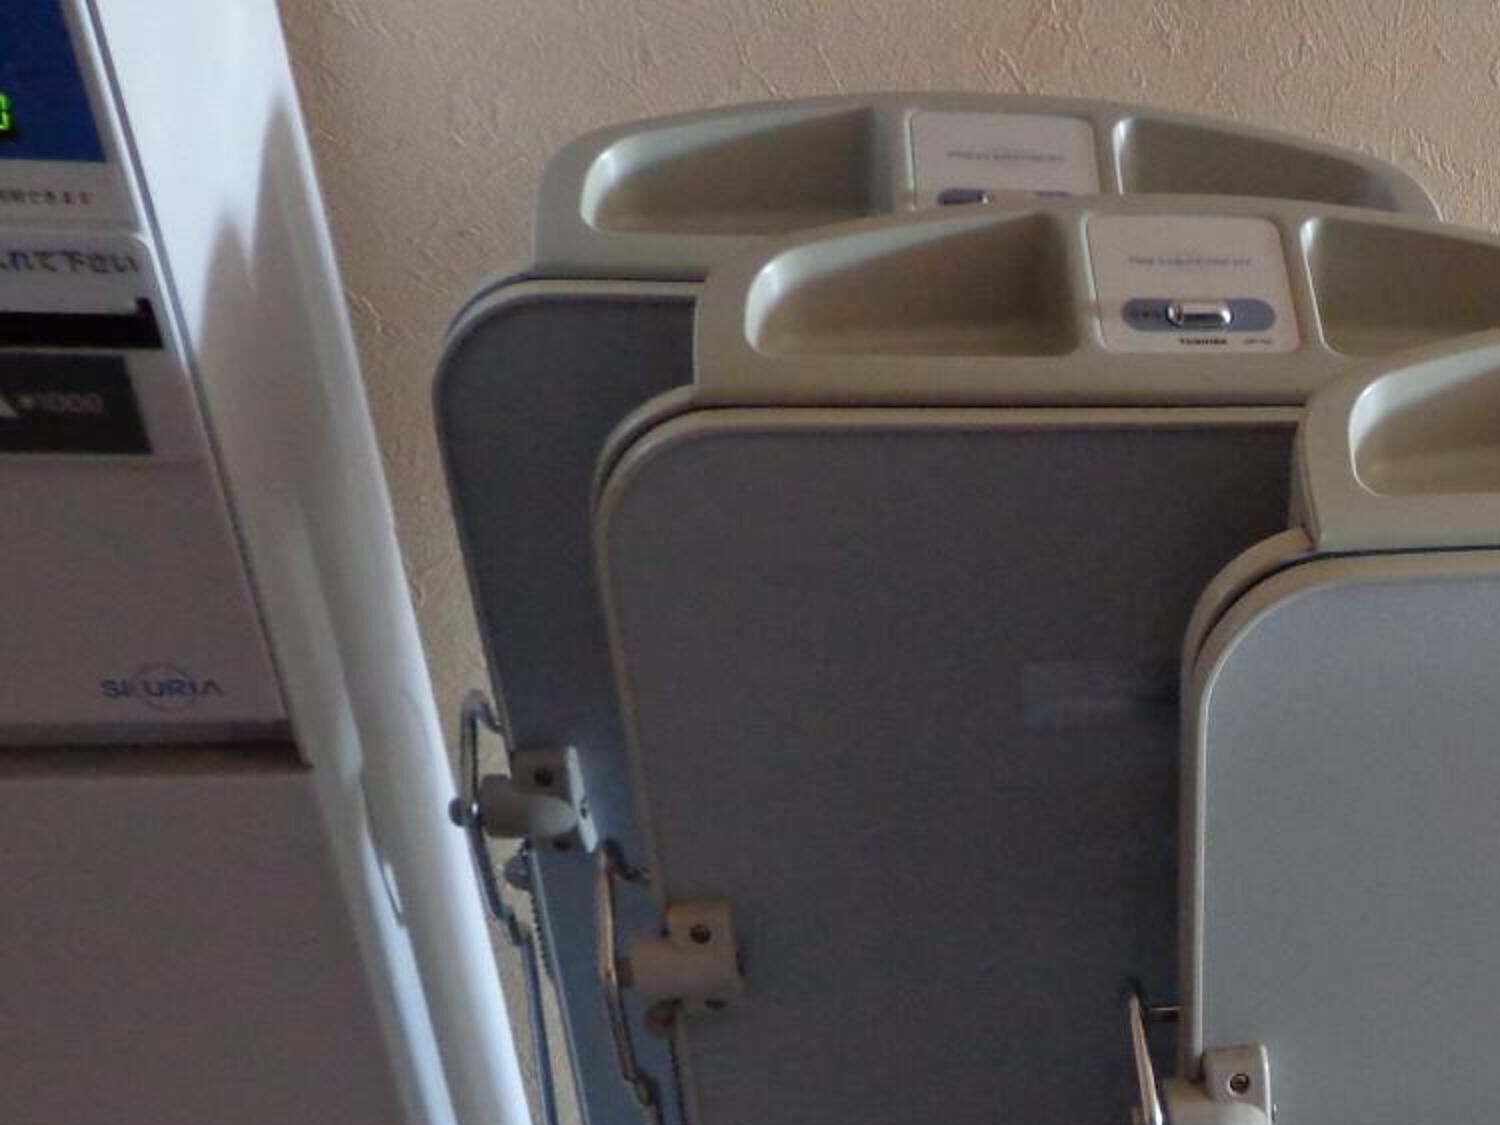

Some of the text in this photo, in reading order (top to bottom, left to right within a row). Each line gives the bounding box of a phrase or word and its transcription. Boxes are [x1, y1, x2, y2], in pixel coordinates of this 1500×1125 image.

[0, 248, 140, 274] れて下さい
